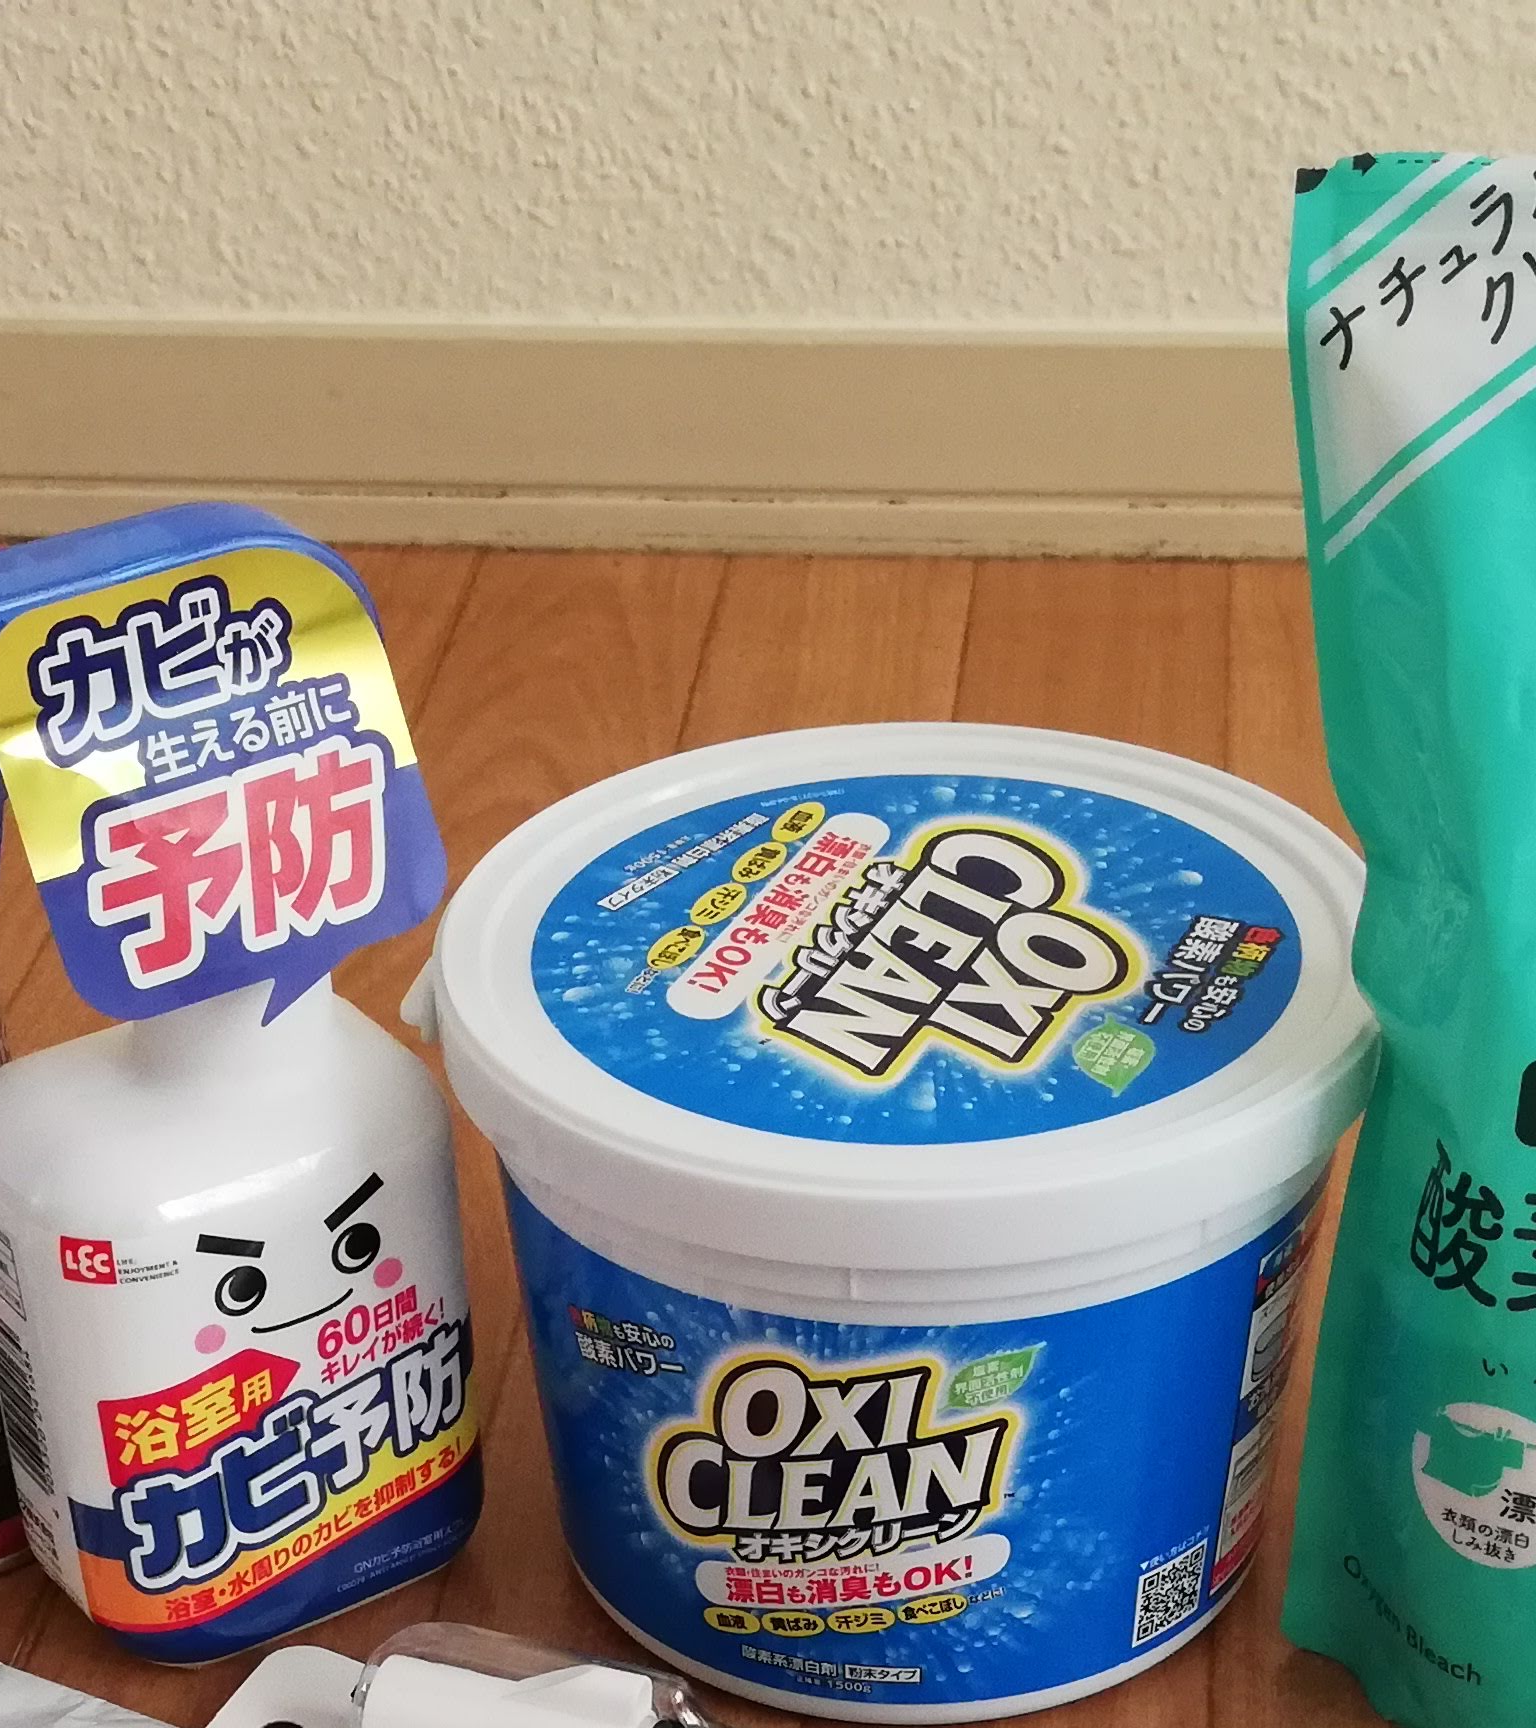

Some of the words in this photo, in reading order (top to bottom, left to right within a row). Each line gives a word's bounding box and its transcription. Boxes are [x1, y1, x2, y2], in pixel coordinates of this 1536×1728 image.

[40, 586, 285, 756] カビが
[146, 680, 351, 782] 生える前に
[94, 742, 378, 980] 予防
[758, 861, 910, 1023] オキシクリーン
[788, 833, 1056, 1070] CLEAN
[929, 910, 1120, 1058] OXI
[66, 1244, 111, 1279] LEC
[317, 1285, 417, 1360] 60日間
[321, 1297, 445, 1385] キレイが続く!
[576, 1331, 684, 1376] 酸素パワー
[114, 1368, 273, 1466] 浴室用
[121, 1328, 463, 1589] カビ予防
[719, 1366, 931, 1458] OXI
[664, 1425, 1001, 1532] CLEAN
[165, 1441, 463, 1622] 浴室・水周りのカビを抑制する!
[737, 1510, 978, 1561] オキシクリーン
[1440, 1507, 1530, 1550] 衣類の漂白
[1452, 1528, 1516, 1563] しみ抜き
[716, 1613, 748, 1631] 血液
[835, 1614, 888, 1629] 汗ジミ
[901, 1598, 966, 1619] 食べこぼし
[726, 1554, 974, 1605] 漂白も消臭もOK!
